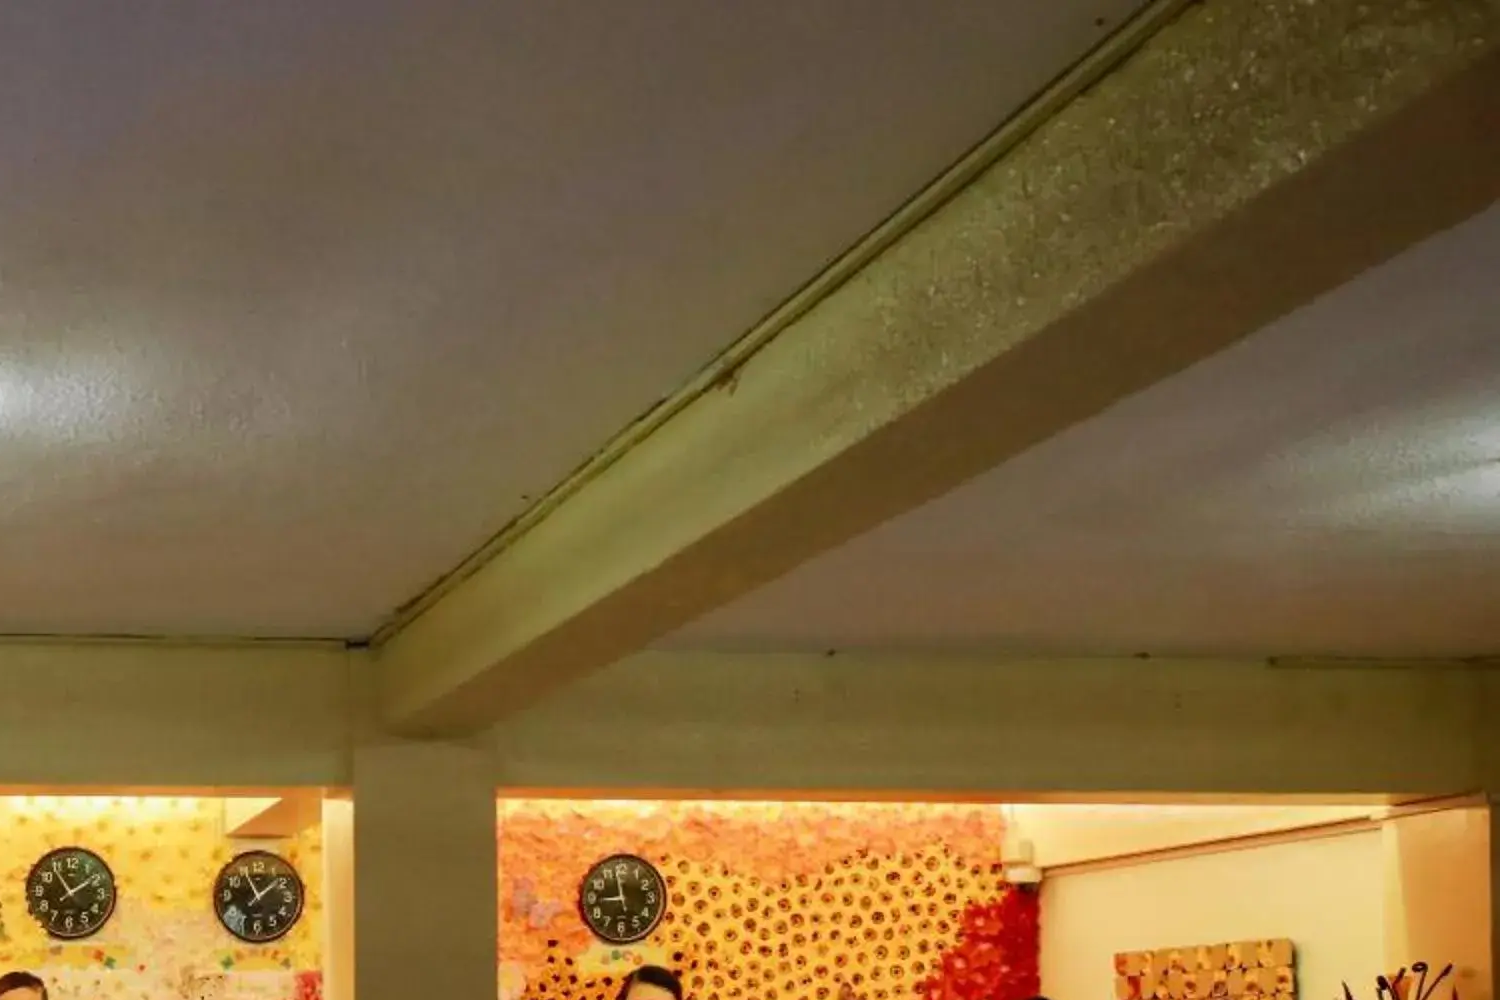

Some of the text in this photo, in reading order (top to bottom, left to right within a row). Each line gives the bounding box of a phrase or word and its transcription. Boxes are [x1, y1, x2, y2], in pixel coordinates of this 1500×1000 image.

[66, 858, 79, 869] 12
[252, 862, 265, 873] 12
[91, 874, 100, 887] 2
[229, 876, 241, 888] 10
[641, 880, 649, 891] 2
[97, 888, 105, 899] 3
[647, 892, 656, 904] 3
[50, 910, 58, 921] 7
[81, 912, 89, 923] 5
[65, 916, 73, 928] 6
[269, 916, 277, 927] 5
[604, 916, 611, 927] 7
